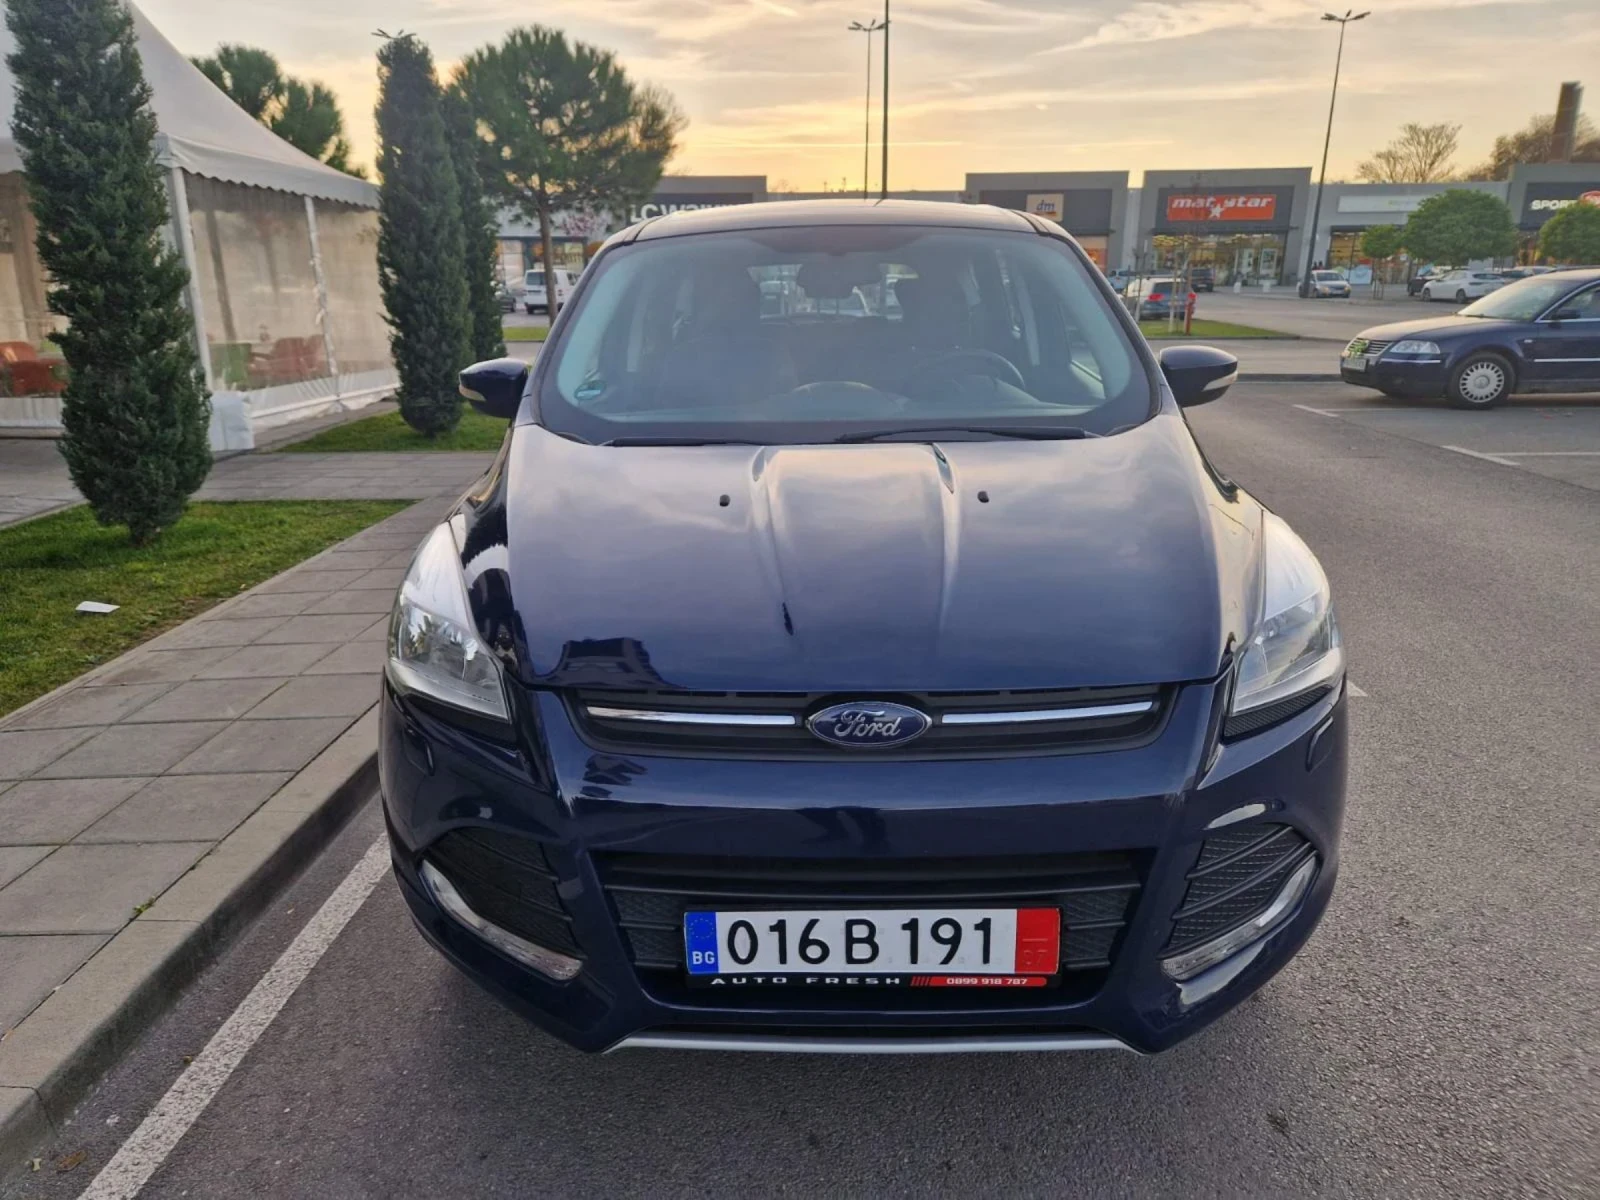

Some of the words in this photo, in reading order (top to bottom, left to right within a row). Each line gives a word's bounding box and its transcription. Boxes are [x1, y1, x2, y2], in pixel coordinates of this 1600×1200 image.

[1036, 200, 1055, 211] dm
[834, 710, 902, 736] Ford
[727, 918, 830, 965] 016
[901, 917, 992, 965] 191
[692, 951, 715, 965] BG
[711, 977, 787, 985] AUTO
[806, 977, 900, 985] FRESH
[946, 977, 978, 985] 0899
[981, 977, 1002, 985] 918
